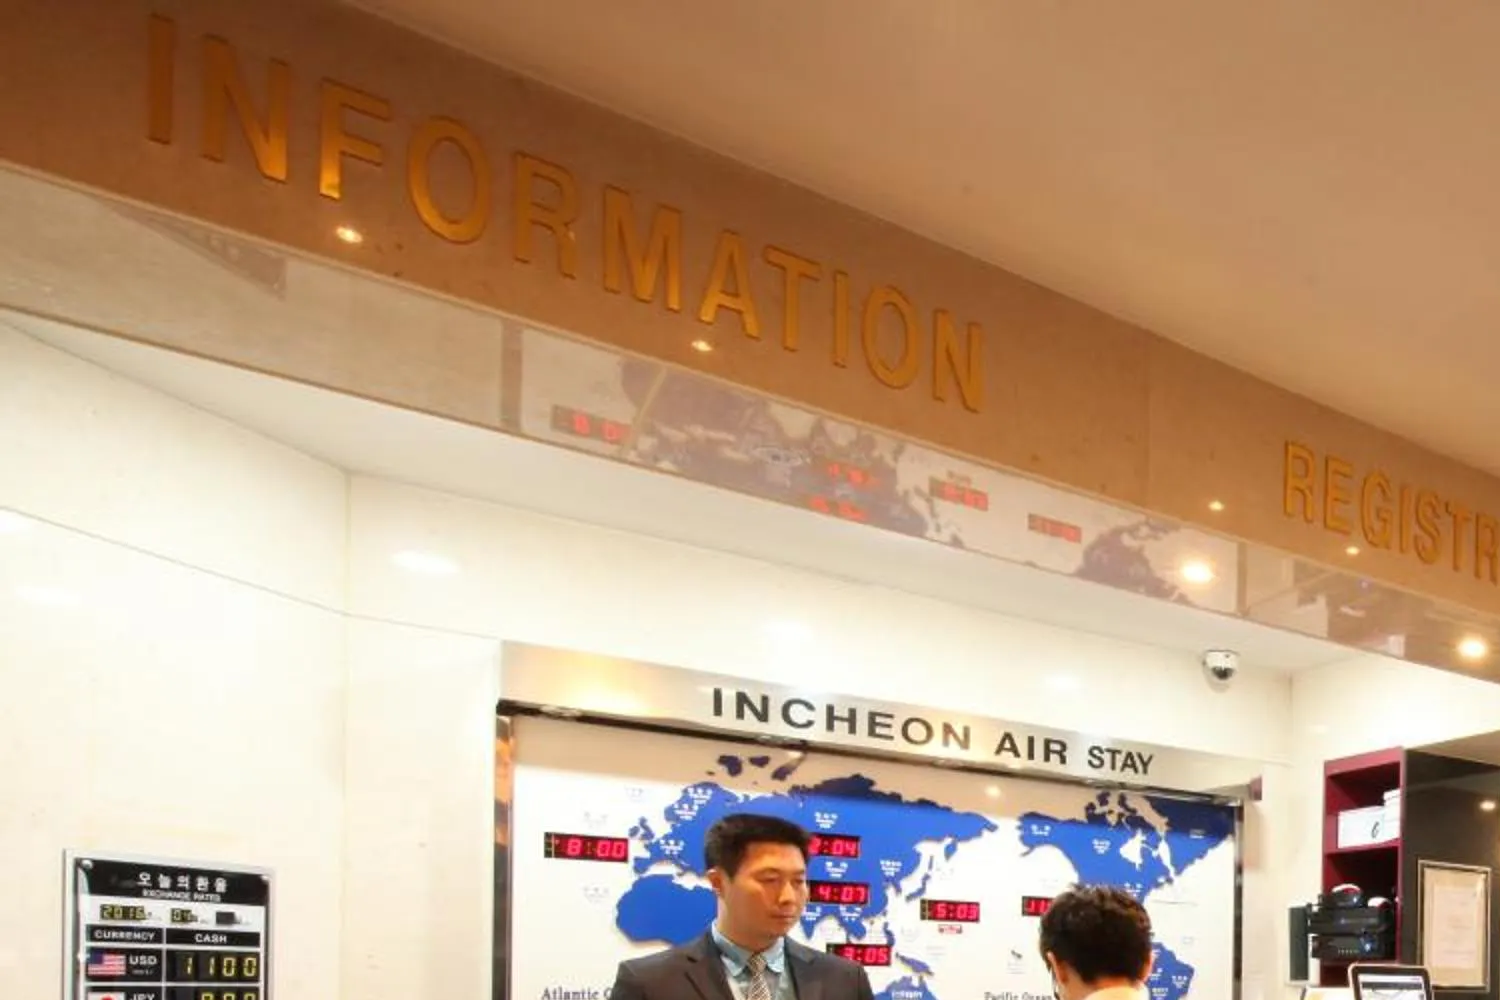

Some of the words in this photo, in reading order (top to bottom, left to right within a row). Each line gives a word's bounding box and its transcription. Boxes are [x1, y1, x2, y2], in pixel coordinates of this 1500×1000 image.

[147, 14, 983, 413] INFORMATION
[712, 686, 972, 752] INCHEON
[995, 731, 1068, 766] AIR
[1087, 745, 1154, 775] STAY
[195, 933, 228, 943] CASH
[128, 955, 158, 965] USD
[186, 956, 257, 977] 1100
[541, 986, 600, 1000] Atlantic
